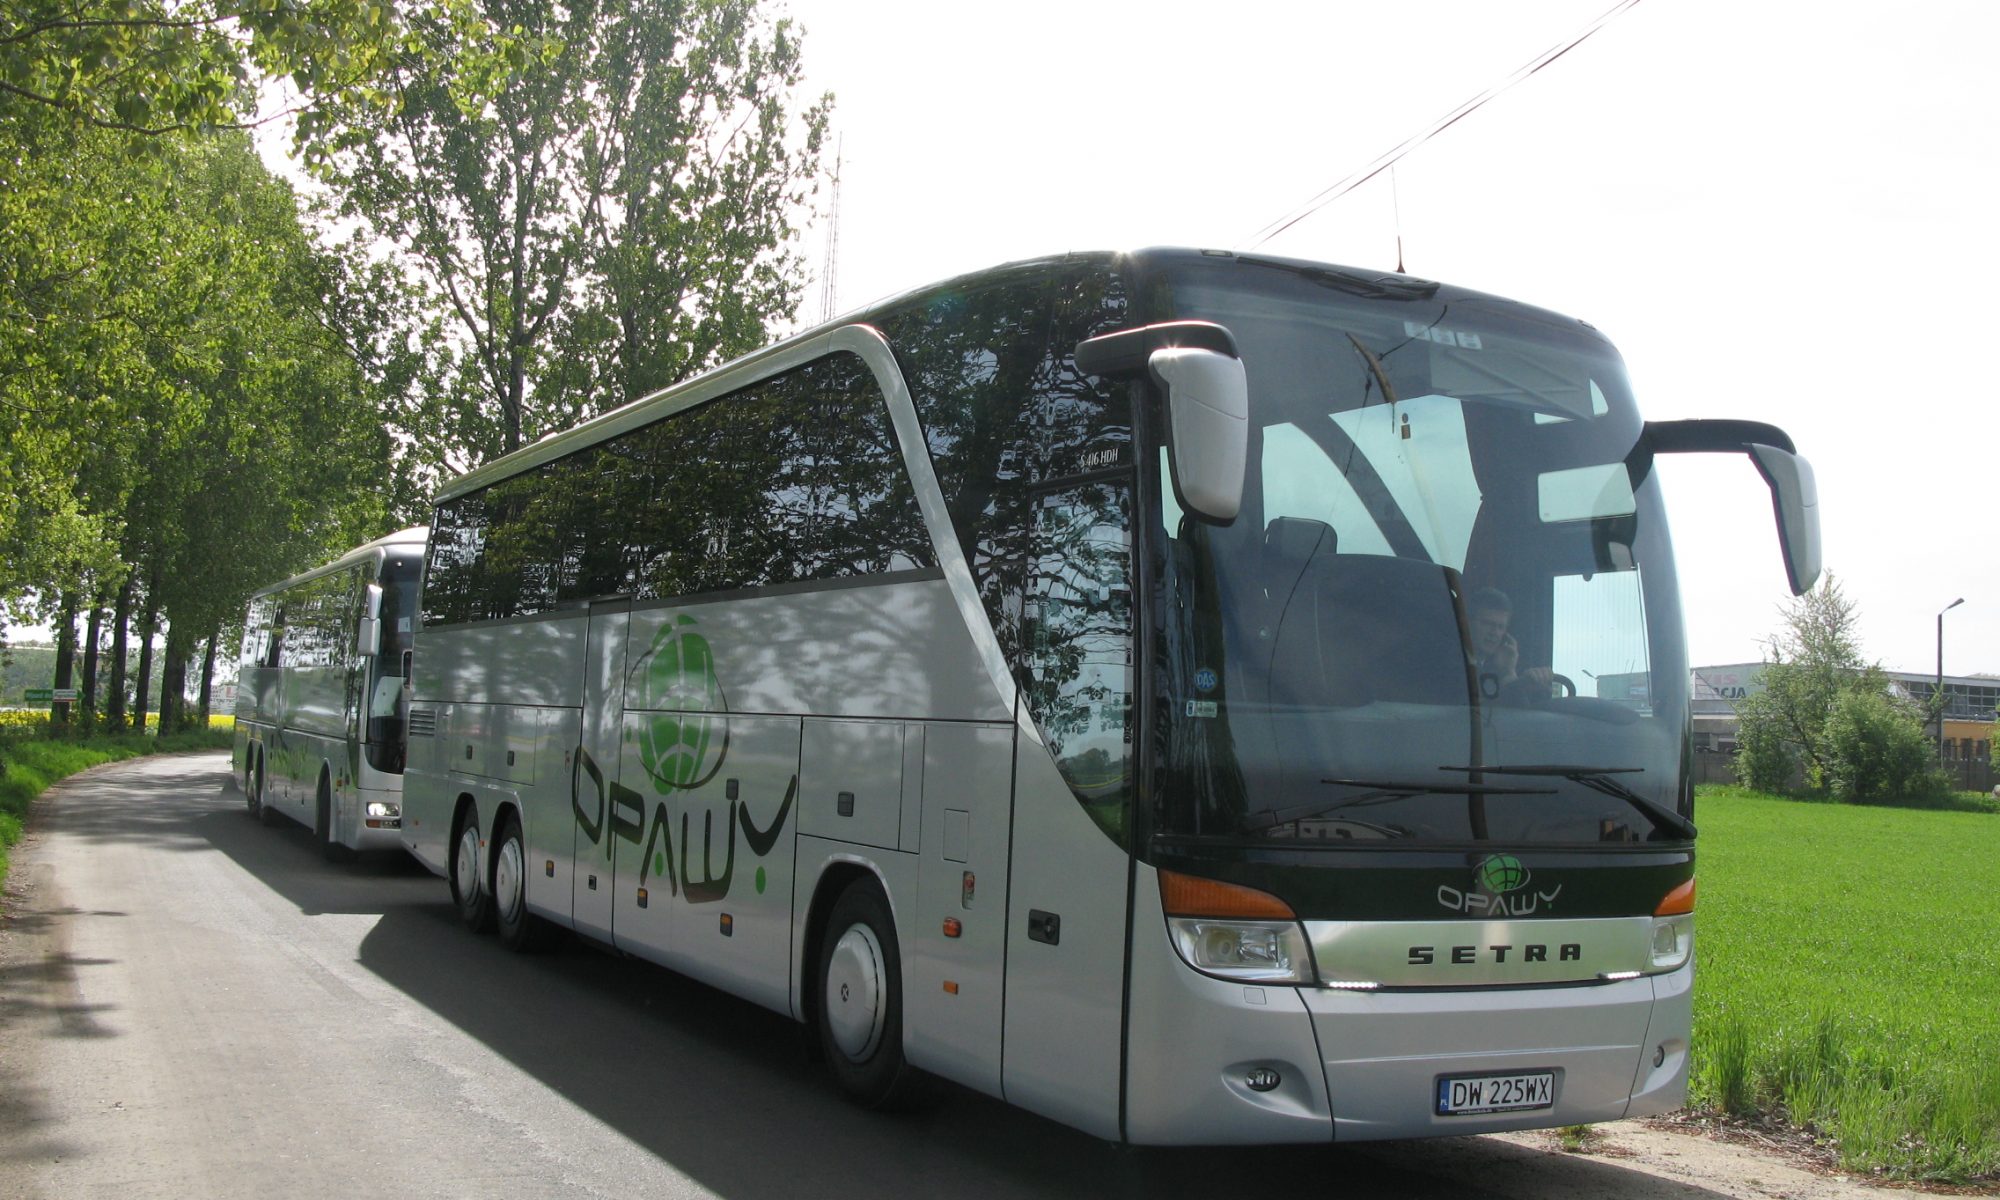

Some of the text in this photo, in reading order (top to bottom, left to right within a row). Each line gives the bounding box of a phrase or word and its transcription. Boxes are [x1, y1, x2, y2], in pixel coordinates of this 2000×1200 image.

[1087, 451, 1100, 467] 416
[1101, 448, 1119, 464] HDH
[572, 745, 797, 903] OPAWY
[1438, 884, 1562, 915] OPAWY
[1408, 944, 1582, 965] SETRA
[1453, 1078, 1550, 1107] DW 225WX
